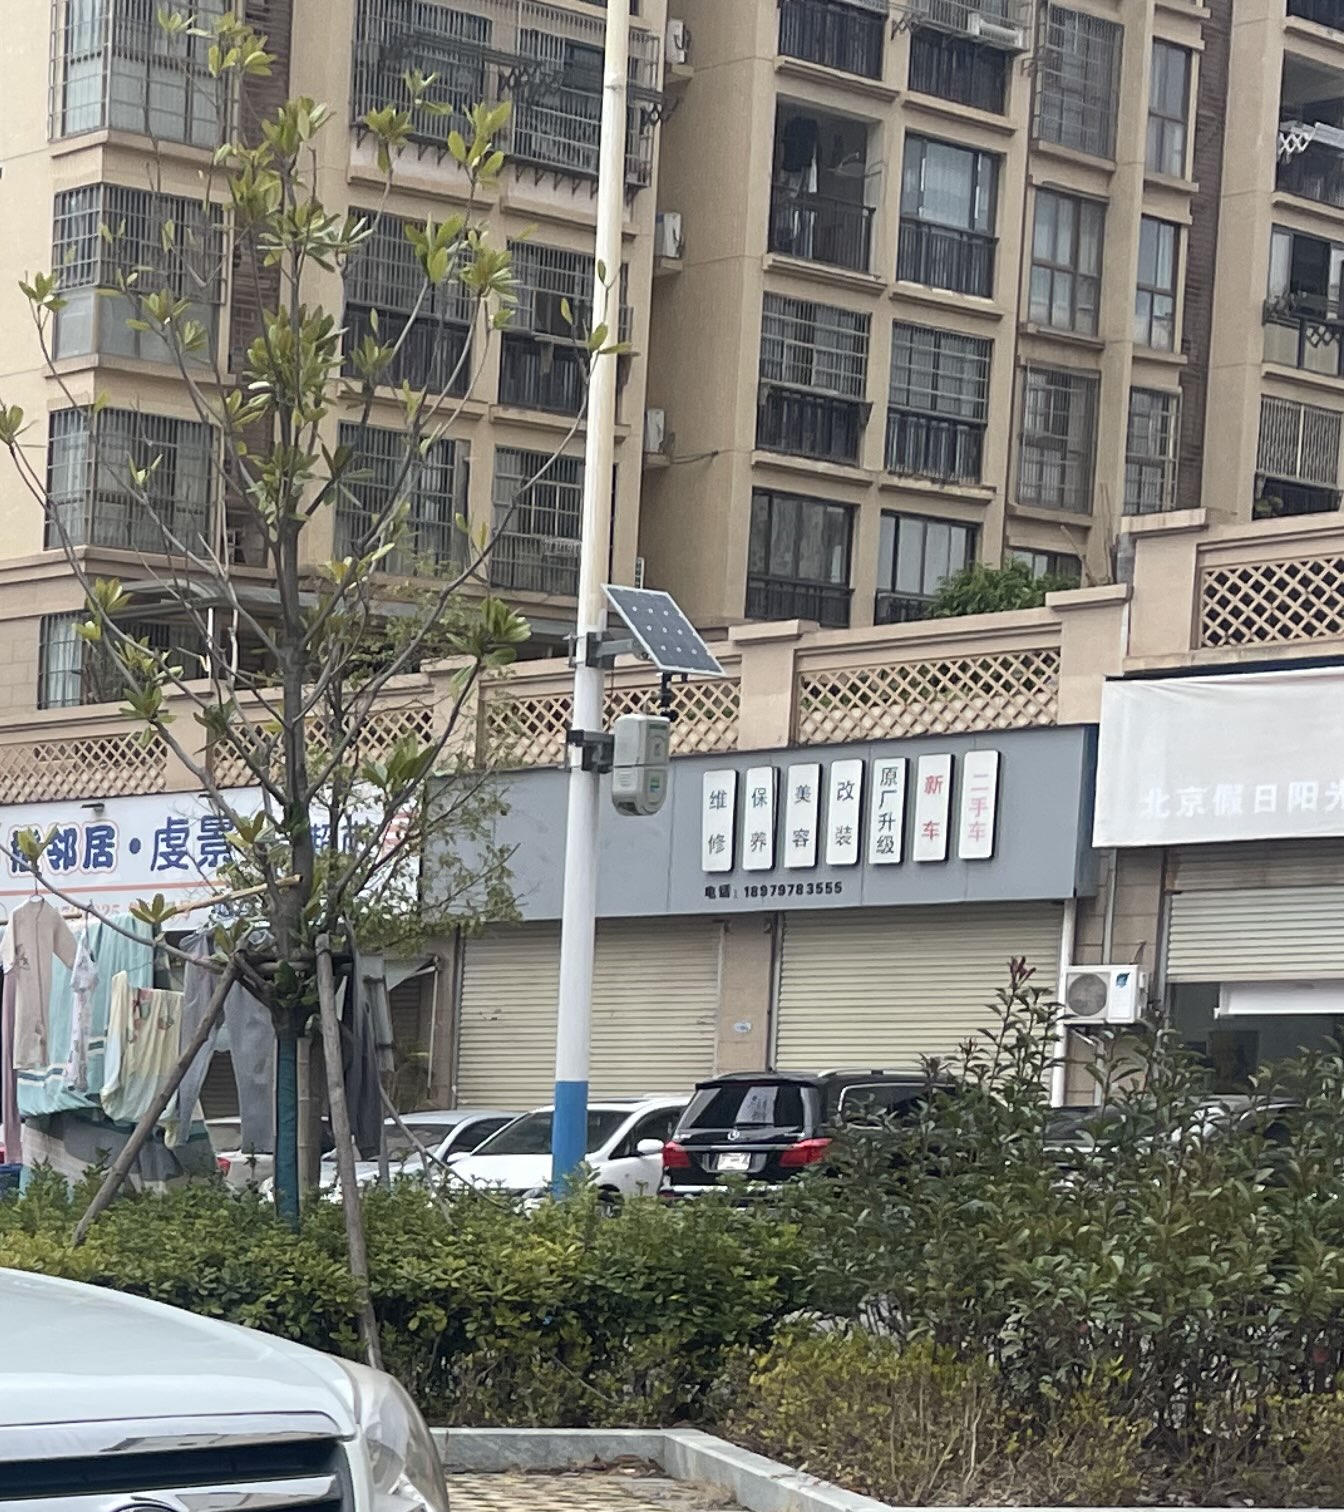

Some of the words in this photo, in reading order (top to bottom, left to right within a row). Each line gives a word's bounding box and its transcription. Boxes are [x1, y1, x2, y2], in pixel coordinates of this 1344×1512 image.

[707, 789, 728, 855] 维修
[749, 787, 768, 853] 保养
[792, 784, 812, 848] 美容
[835, 780, 855, 847] 改装
[876, 766, 899, 855] 原厂升级
[921, 774, 944, 841] 新车
[968, 773, 990, 842] 二手车
